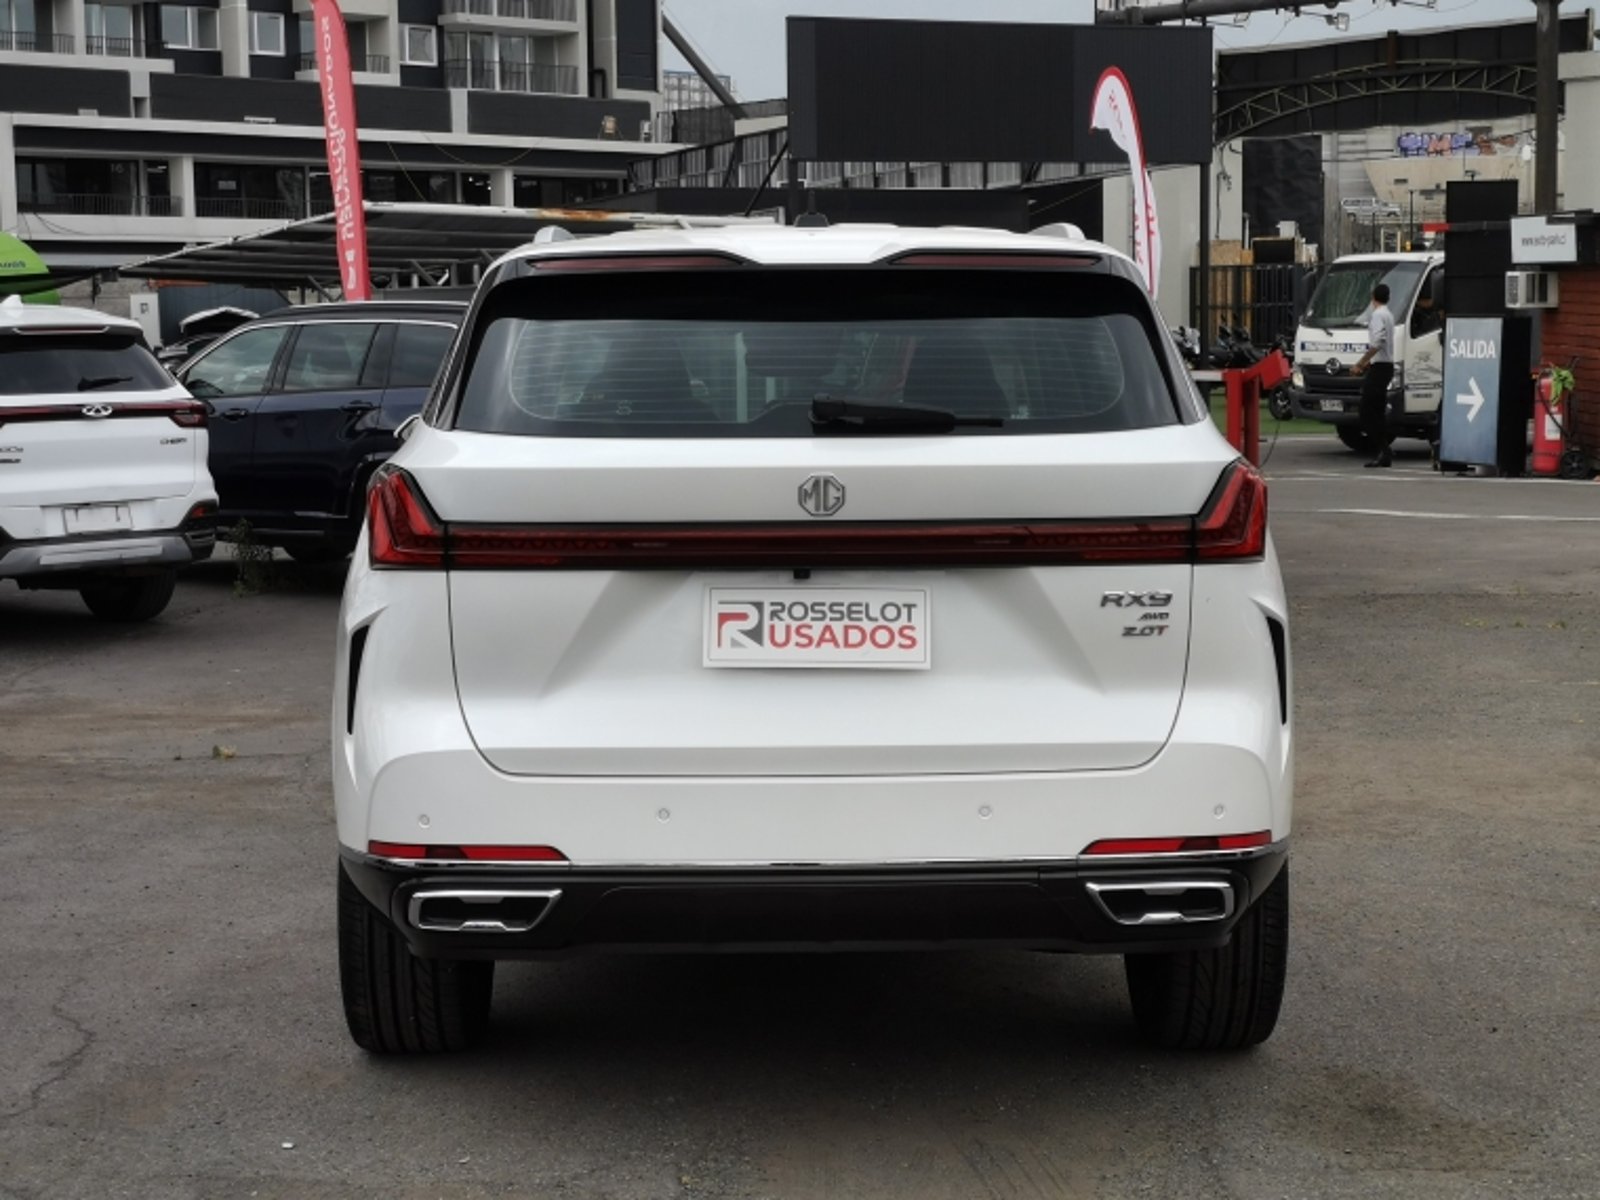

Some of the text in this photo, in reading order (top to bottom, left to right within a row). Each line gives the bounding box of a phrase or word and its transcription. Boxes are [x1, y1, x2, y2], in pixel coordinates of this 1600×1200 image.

[1449, 338, 1496, 359] SALIDA
[802, 477, 842, 513] MG
[1100, 591, 1174, 607] RX9
[769, 601, 918, 623] ROSSELOT
[769, 624, 918, 650] USADOS
[1122, 624, 1168, 636] 2.0T
